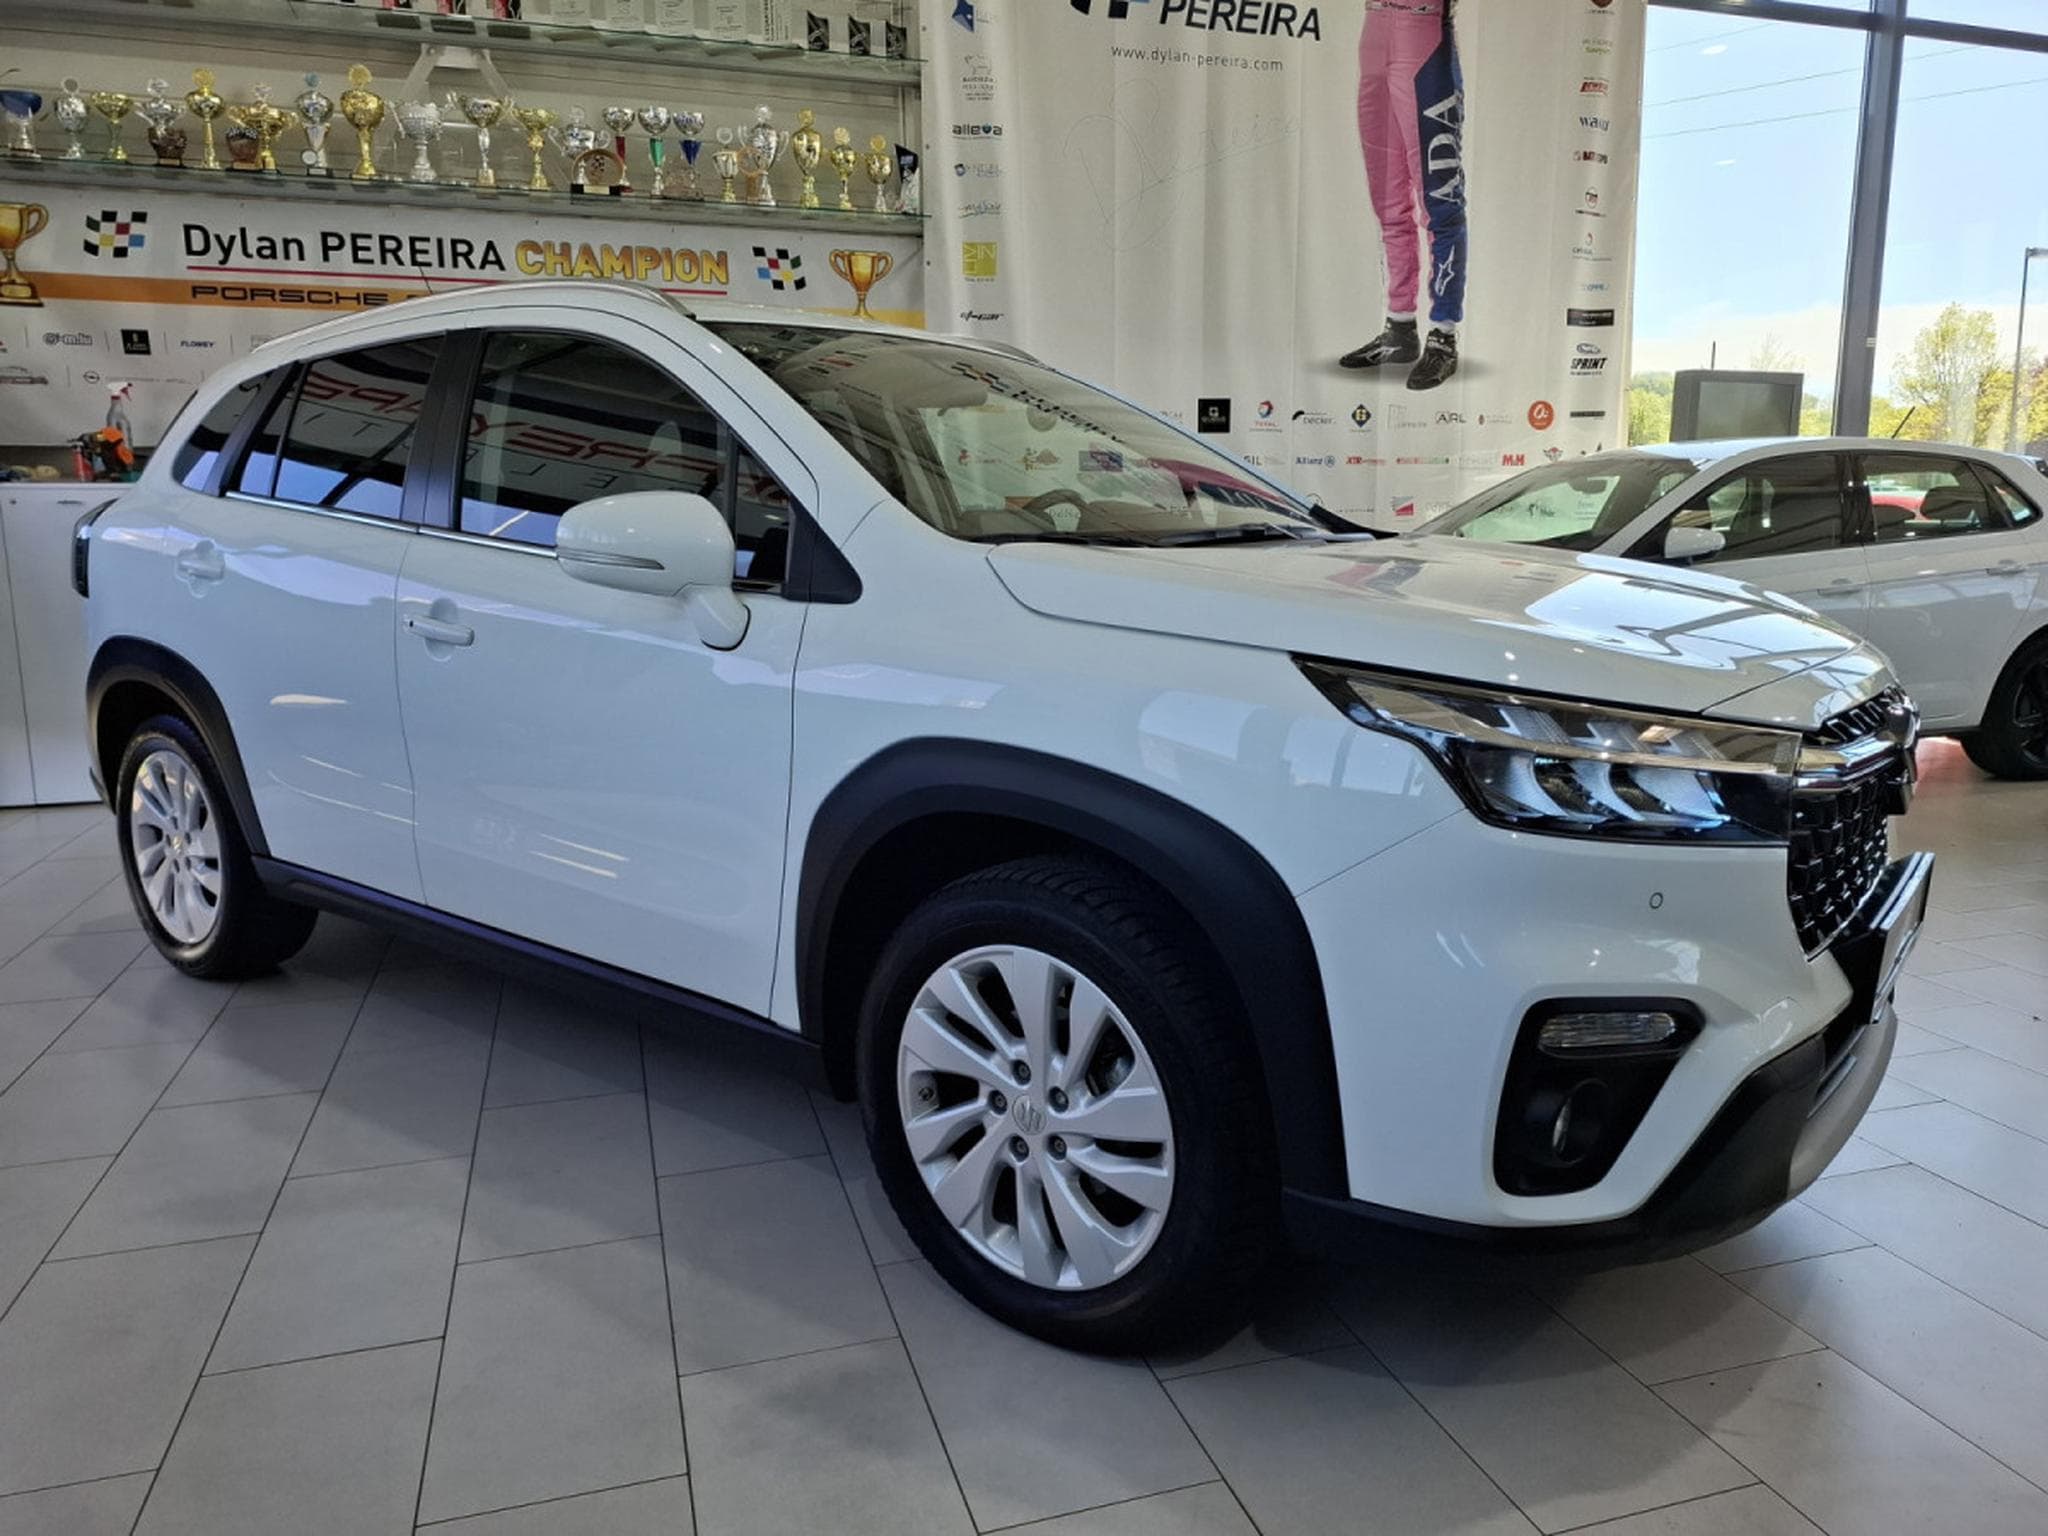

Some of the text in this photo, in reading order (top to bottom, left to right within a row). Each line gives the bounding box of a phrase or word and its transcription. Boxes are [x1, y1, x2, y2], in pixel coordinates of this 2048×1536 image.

[1159, 0, 1321, 42] PEREIRA
[1110, 45, 1284, 72] www.dylan-pereira.com
[1423, 88, 1465, 204] ADA
[183, 223, 729, 285] Dylan PEREIRA CHAMPION
[191, 285, 388, 306] PORSCHE
